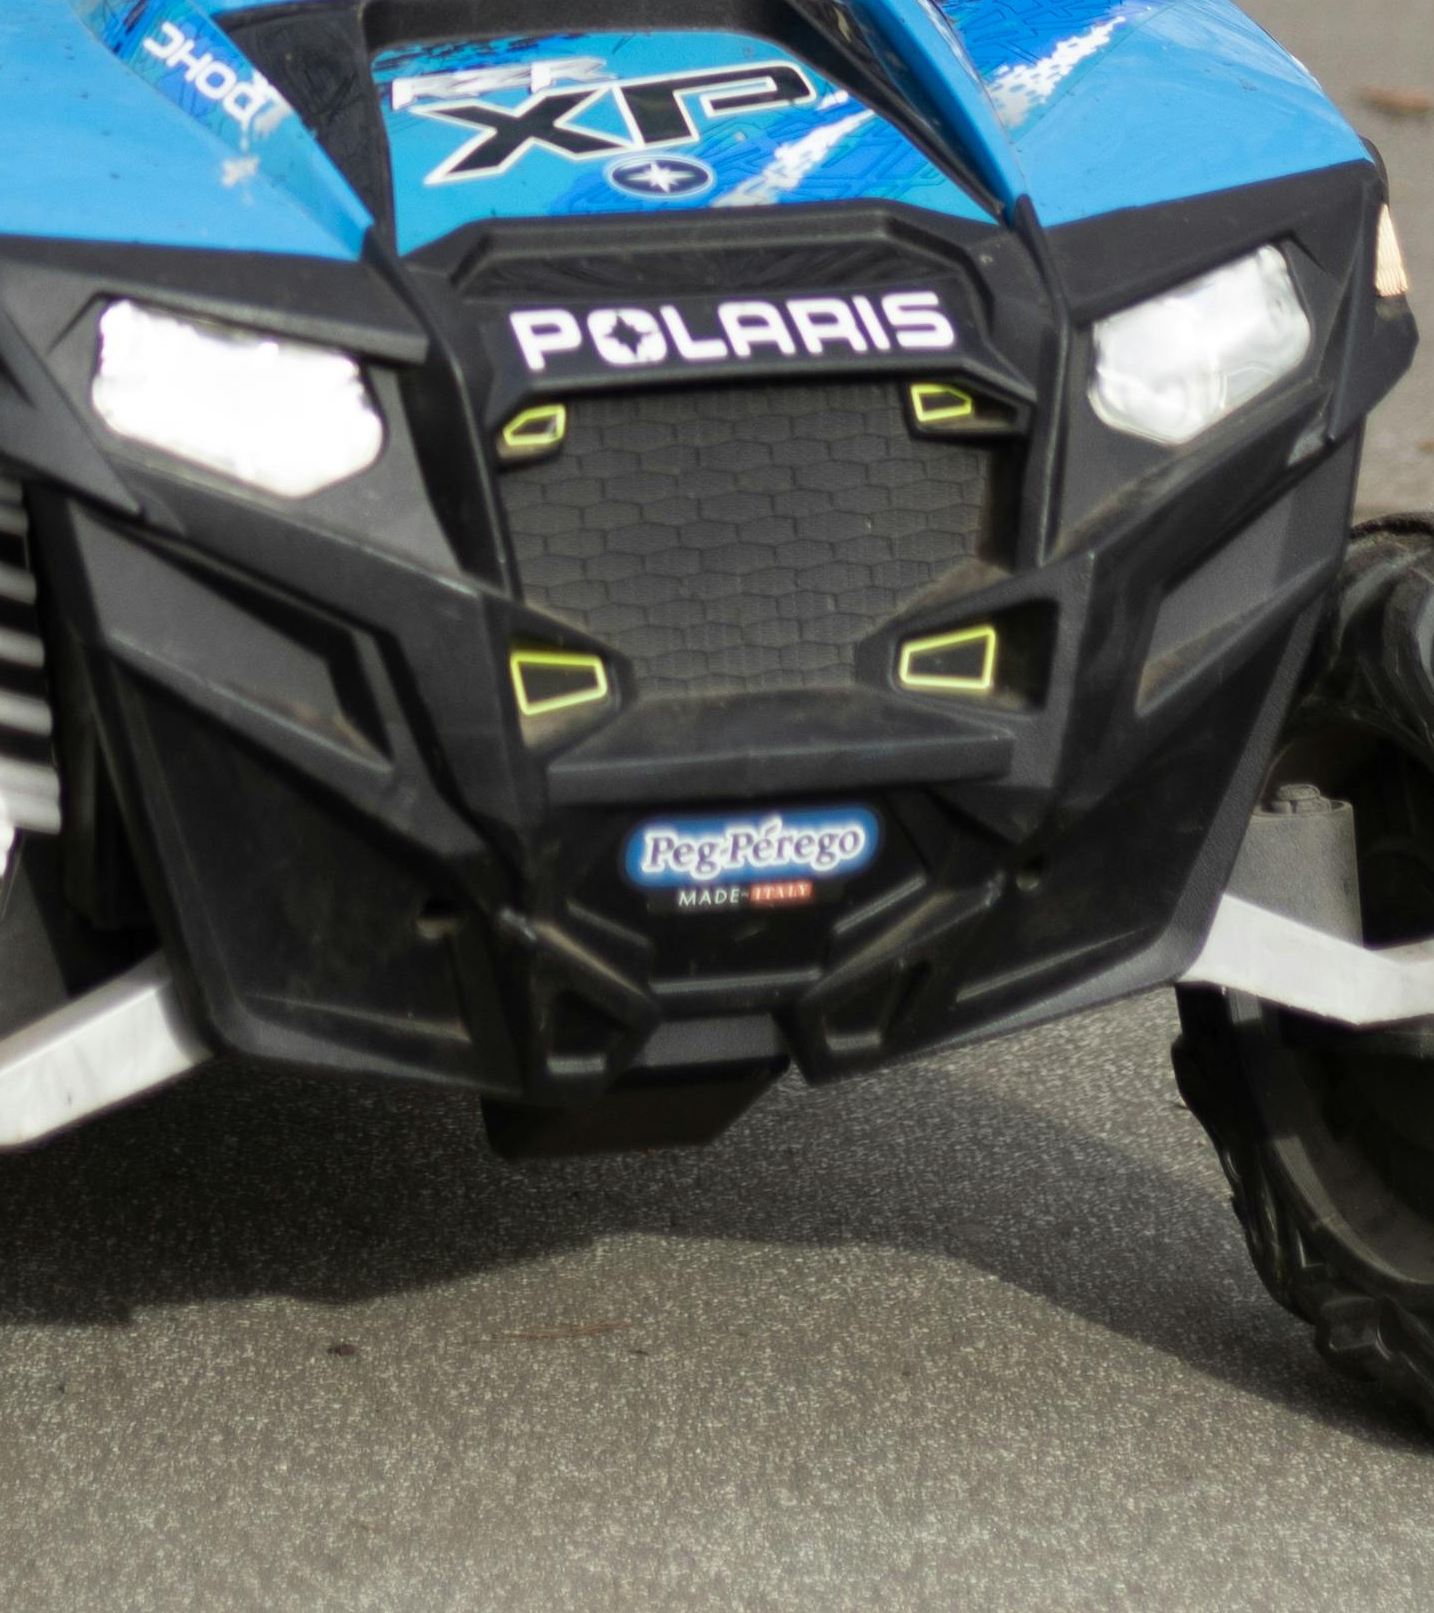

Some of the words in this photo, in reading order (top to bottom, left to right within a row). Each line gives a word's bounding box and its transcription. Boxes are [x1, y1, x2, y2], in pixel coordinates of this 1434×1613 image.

[408, 59, 817, 184] XP
[509, 291, 956, 372] POLARIS
[678, 888, 741, 907] MADE
[753, 882, 810, 901] ITALY
